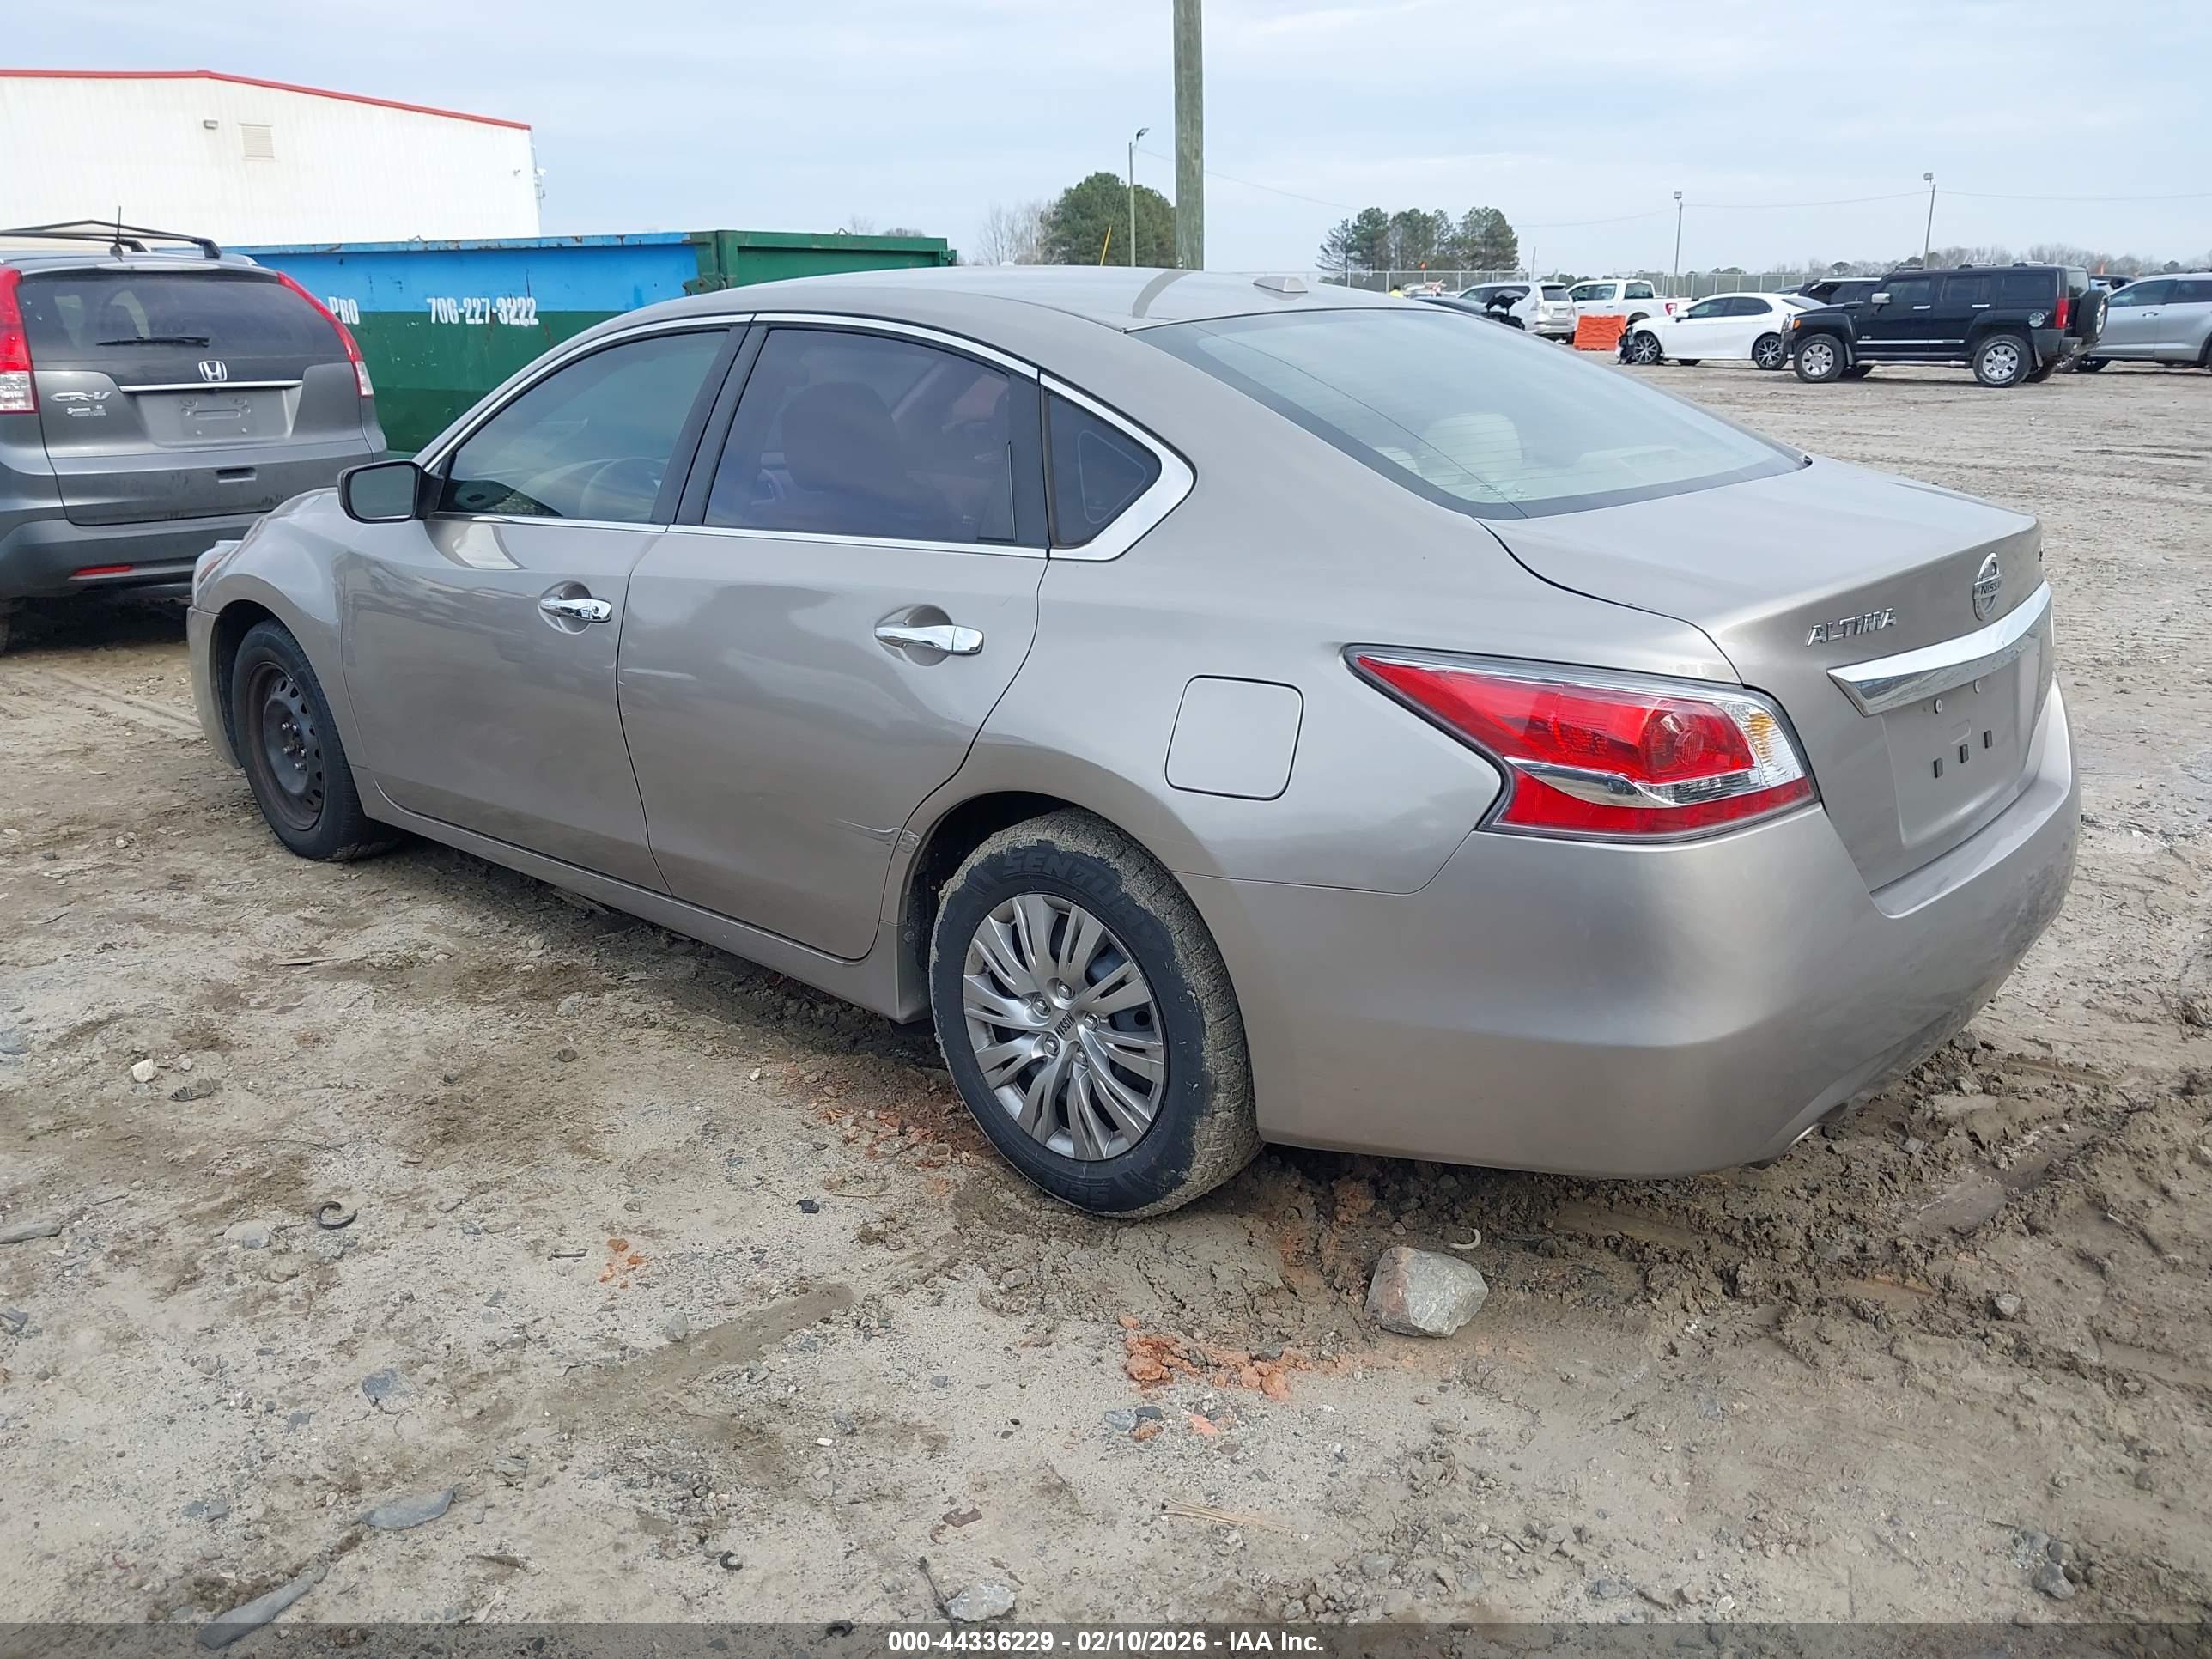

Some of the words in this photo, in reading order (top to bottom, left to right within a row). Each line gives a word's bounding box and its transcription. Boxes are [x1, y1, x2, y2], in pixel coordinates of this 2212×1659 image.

[427, 297, 539, 326] 706-227-3222
[51, 391, 112, 402] CR-V
[1805, 607, 1897, 647] ALTIMA
